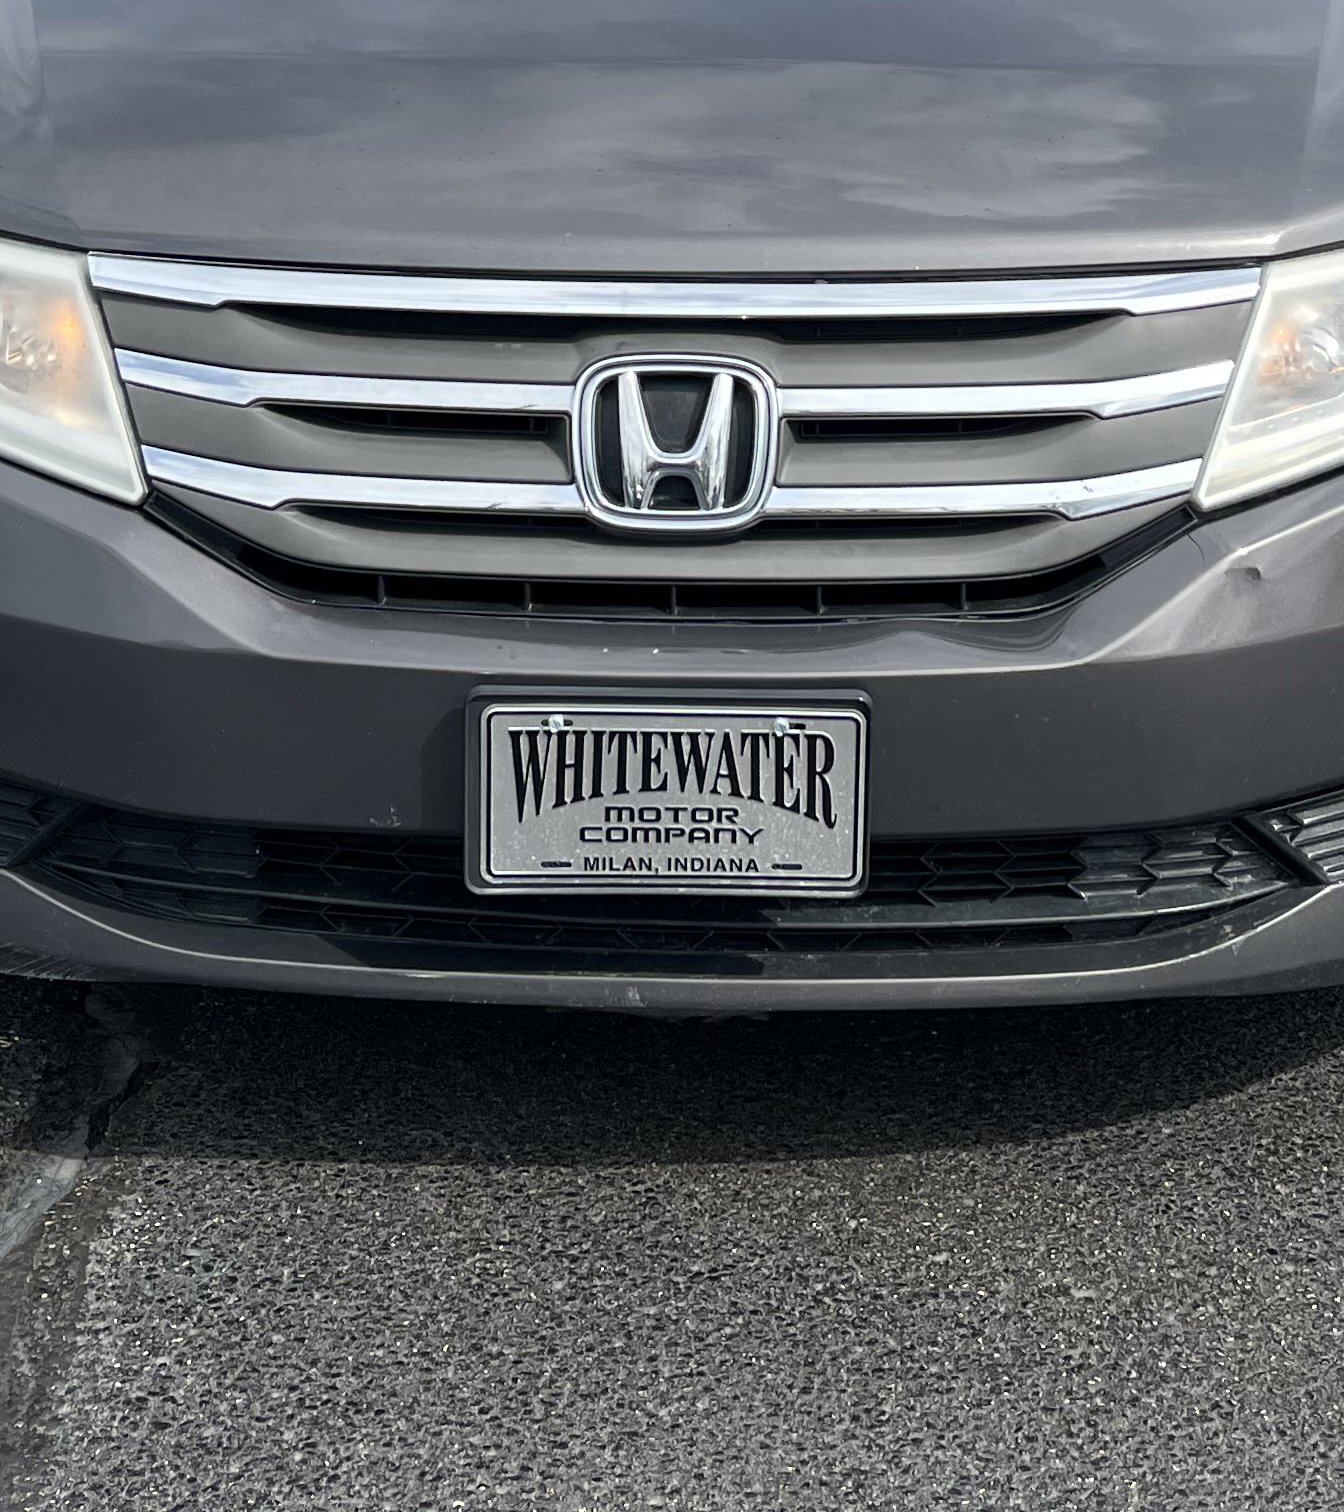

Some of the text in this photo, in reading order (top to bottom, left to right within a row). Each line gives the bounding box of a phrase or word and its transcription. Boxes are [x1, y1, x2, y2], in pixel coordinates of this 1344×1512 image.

[508, 727, 838, 829] WHITEWATER
[604, 805, 740, 824] MOTOR
[579, 826, 764, 844] COMPANY
[583, 857, 760, 875] MILAN, INDIANA
